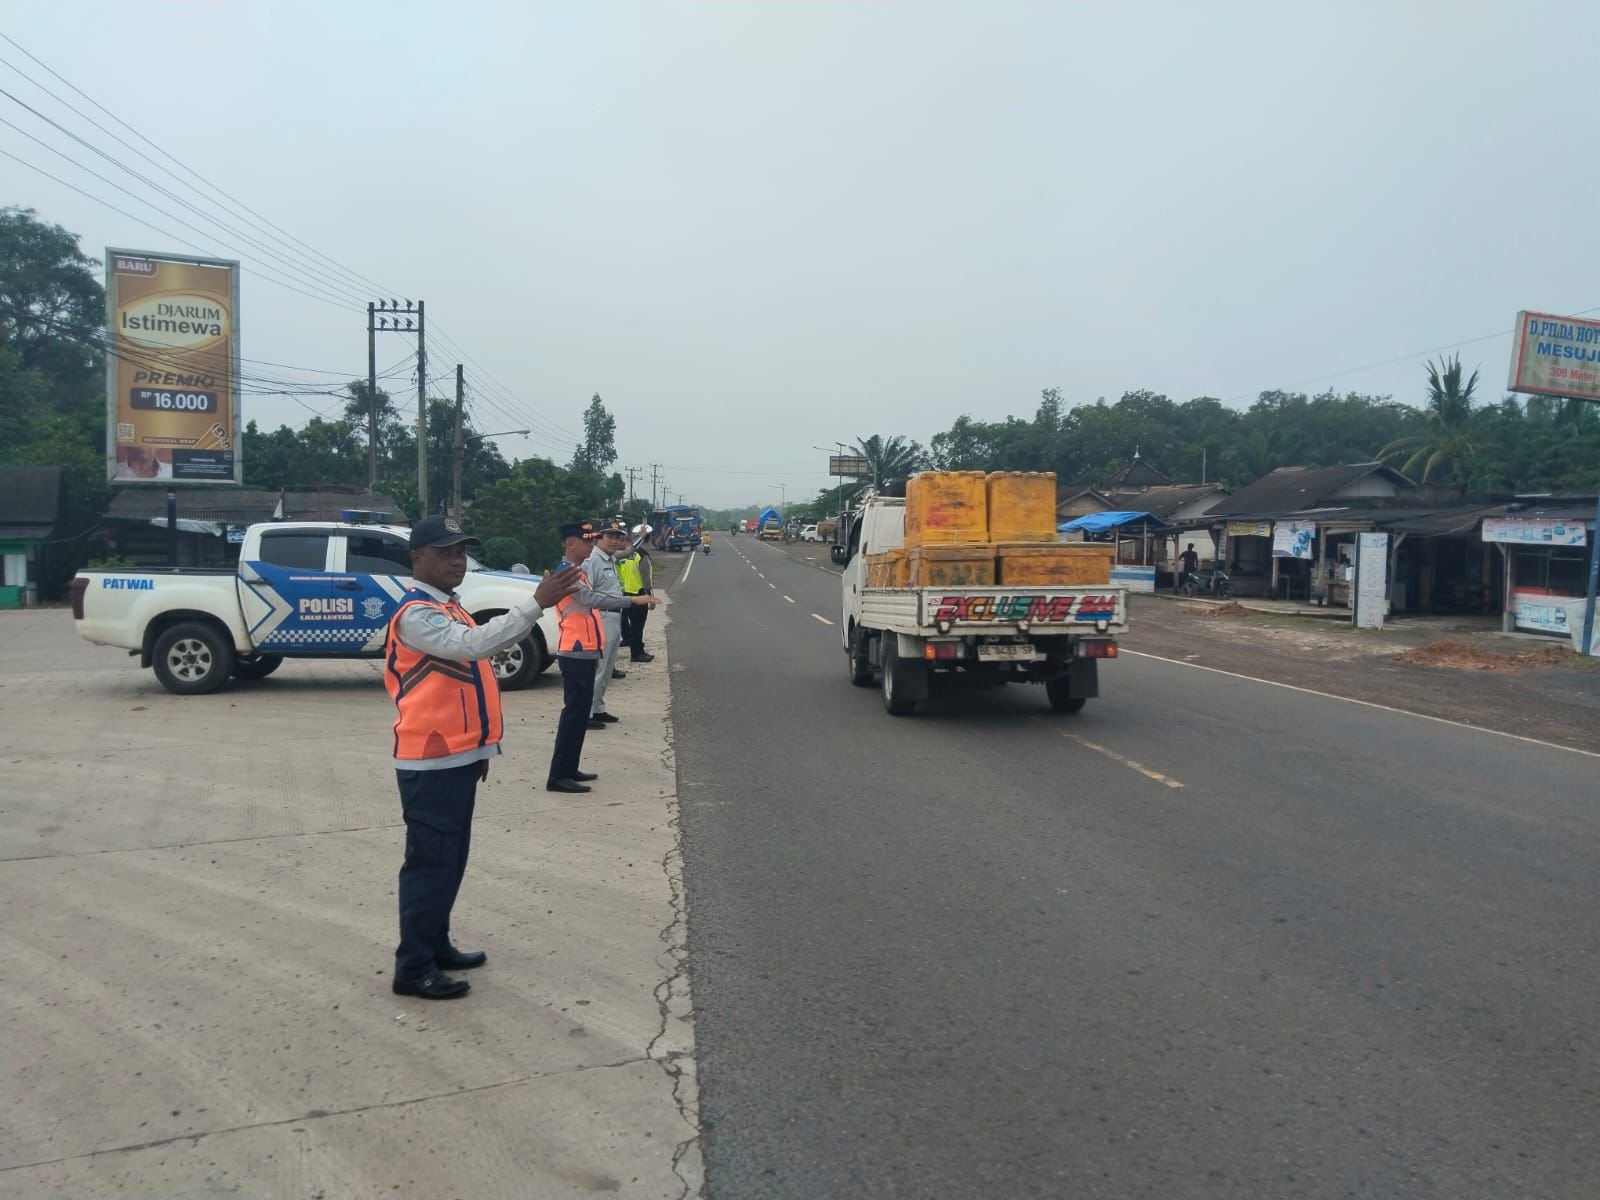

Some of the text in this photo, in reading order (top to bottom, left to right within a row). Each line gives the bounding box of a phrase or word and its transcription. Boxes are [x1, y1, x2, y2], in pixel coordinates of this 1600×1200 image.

[117, 260, 152, 272] BARU
[157, 303, 220, 321] DJARUM
[122, 311, 221, 337] Istimewa
[133, 370, 215, 388] PREMIO
[154, 393, 208, 411] 16.000
[103, 578, 154, 590] PATWAL
[299, 598, 354, 613] POLISI
